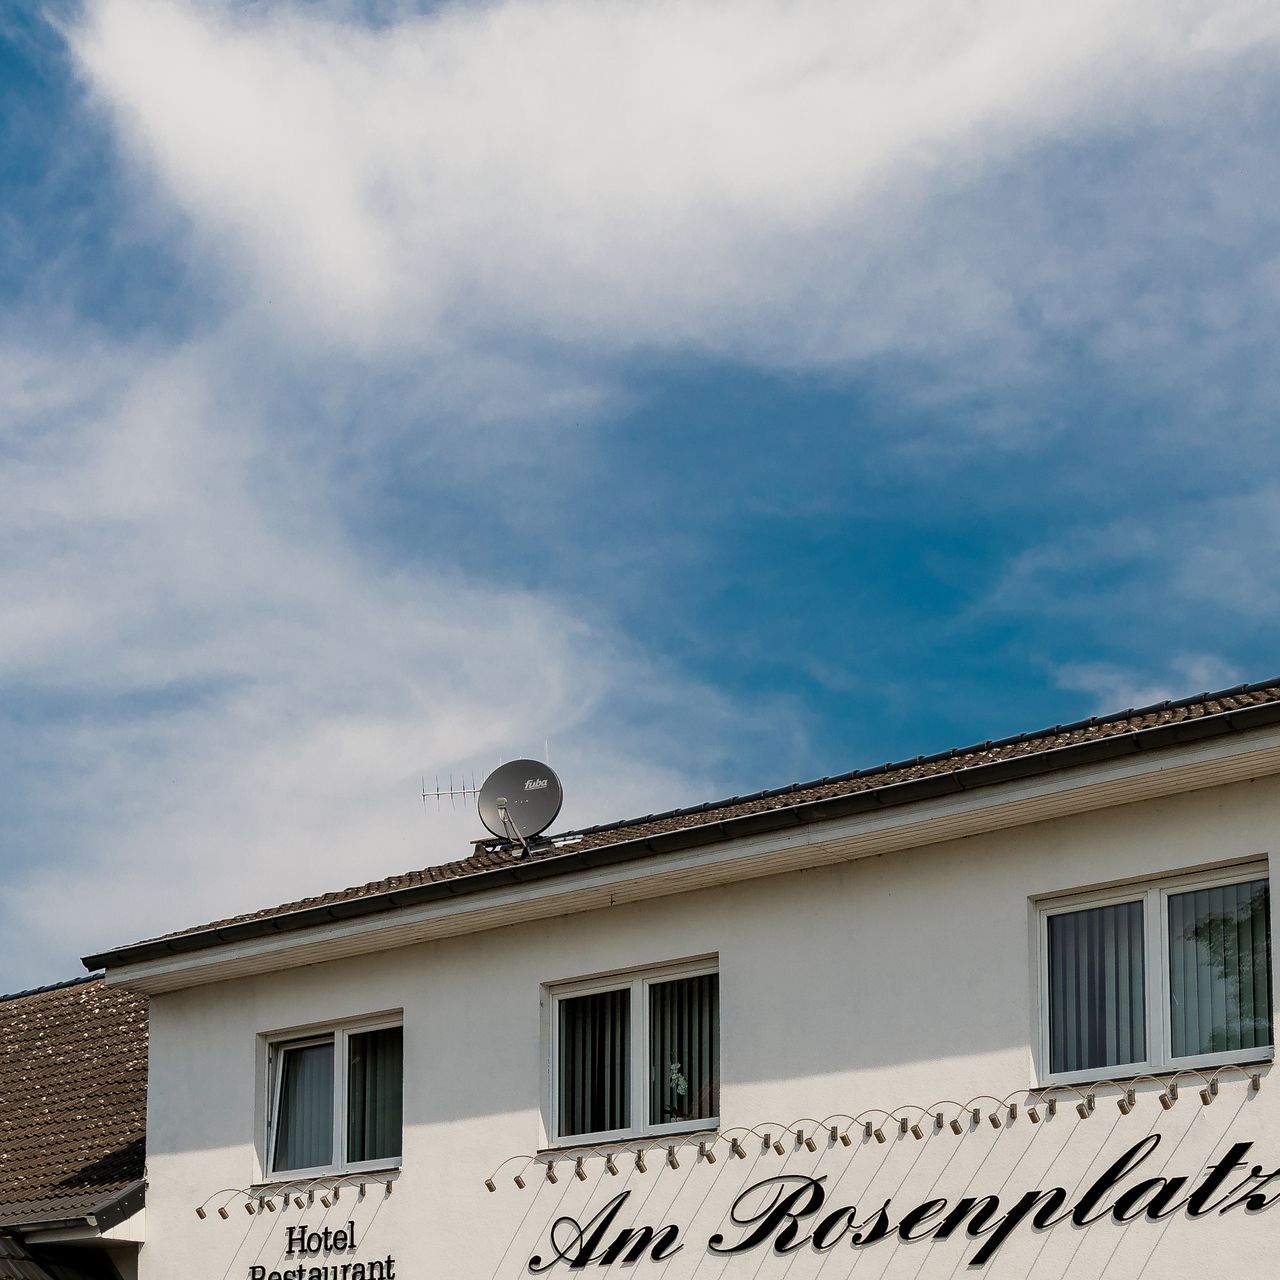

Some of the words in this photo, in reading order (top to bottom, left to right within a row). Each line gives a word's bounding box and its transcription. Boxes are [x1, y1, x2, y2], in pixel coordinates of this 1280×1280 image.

[524, 778, 548, 790] fuba
[285, 1220, 357, 1256] Hotel
[528, 1190, 685, 1273] Am
